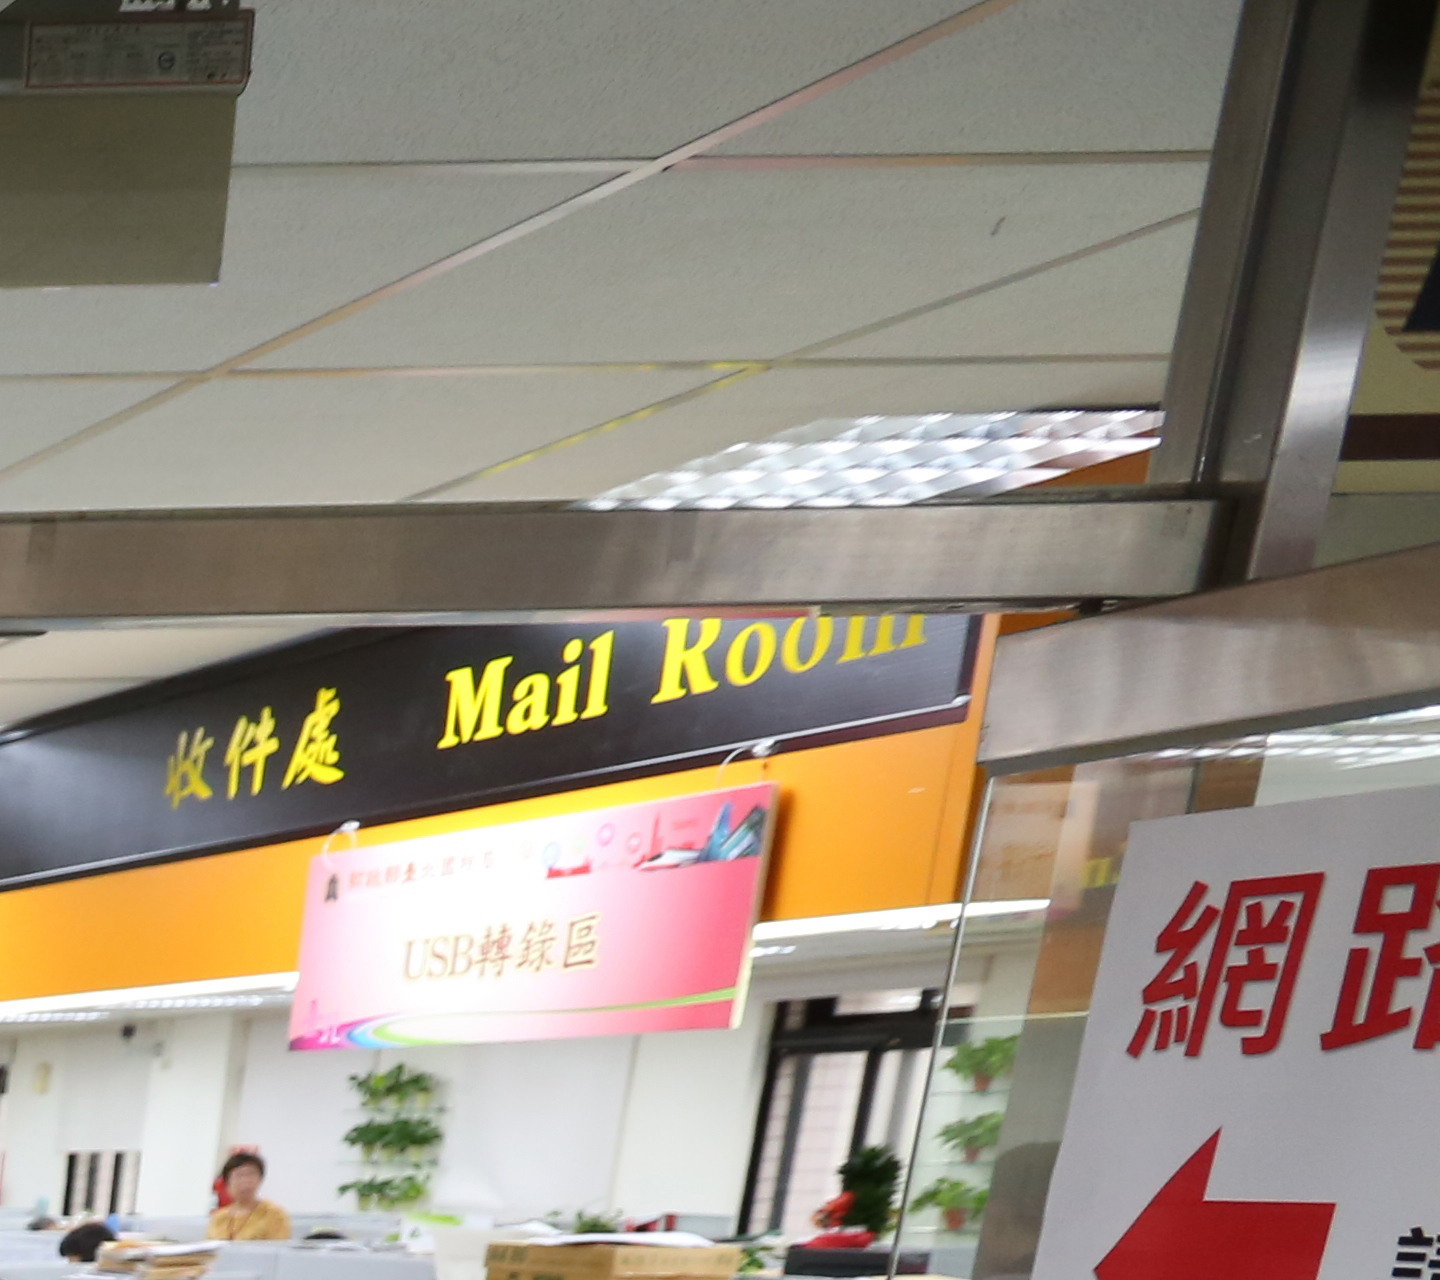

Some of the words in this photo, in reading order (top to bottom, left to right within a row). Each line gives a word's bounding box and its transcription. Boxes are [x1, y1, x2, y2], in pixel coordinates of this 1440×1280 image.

[438, 631, 614, 749] Mail
[651, 615, 928, 704] Room
[164, 687, 345, 810] 收件處
[402, 913, 602, 983] USB轉錄區
